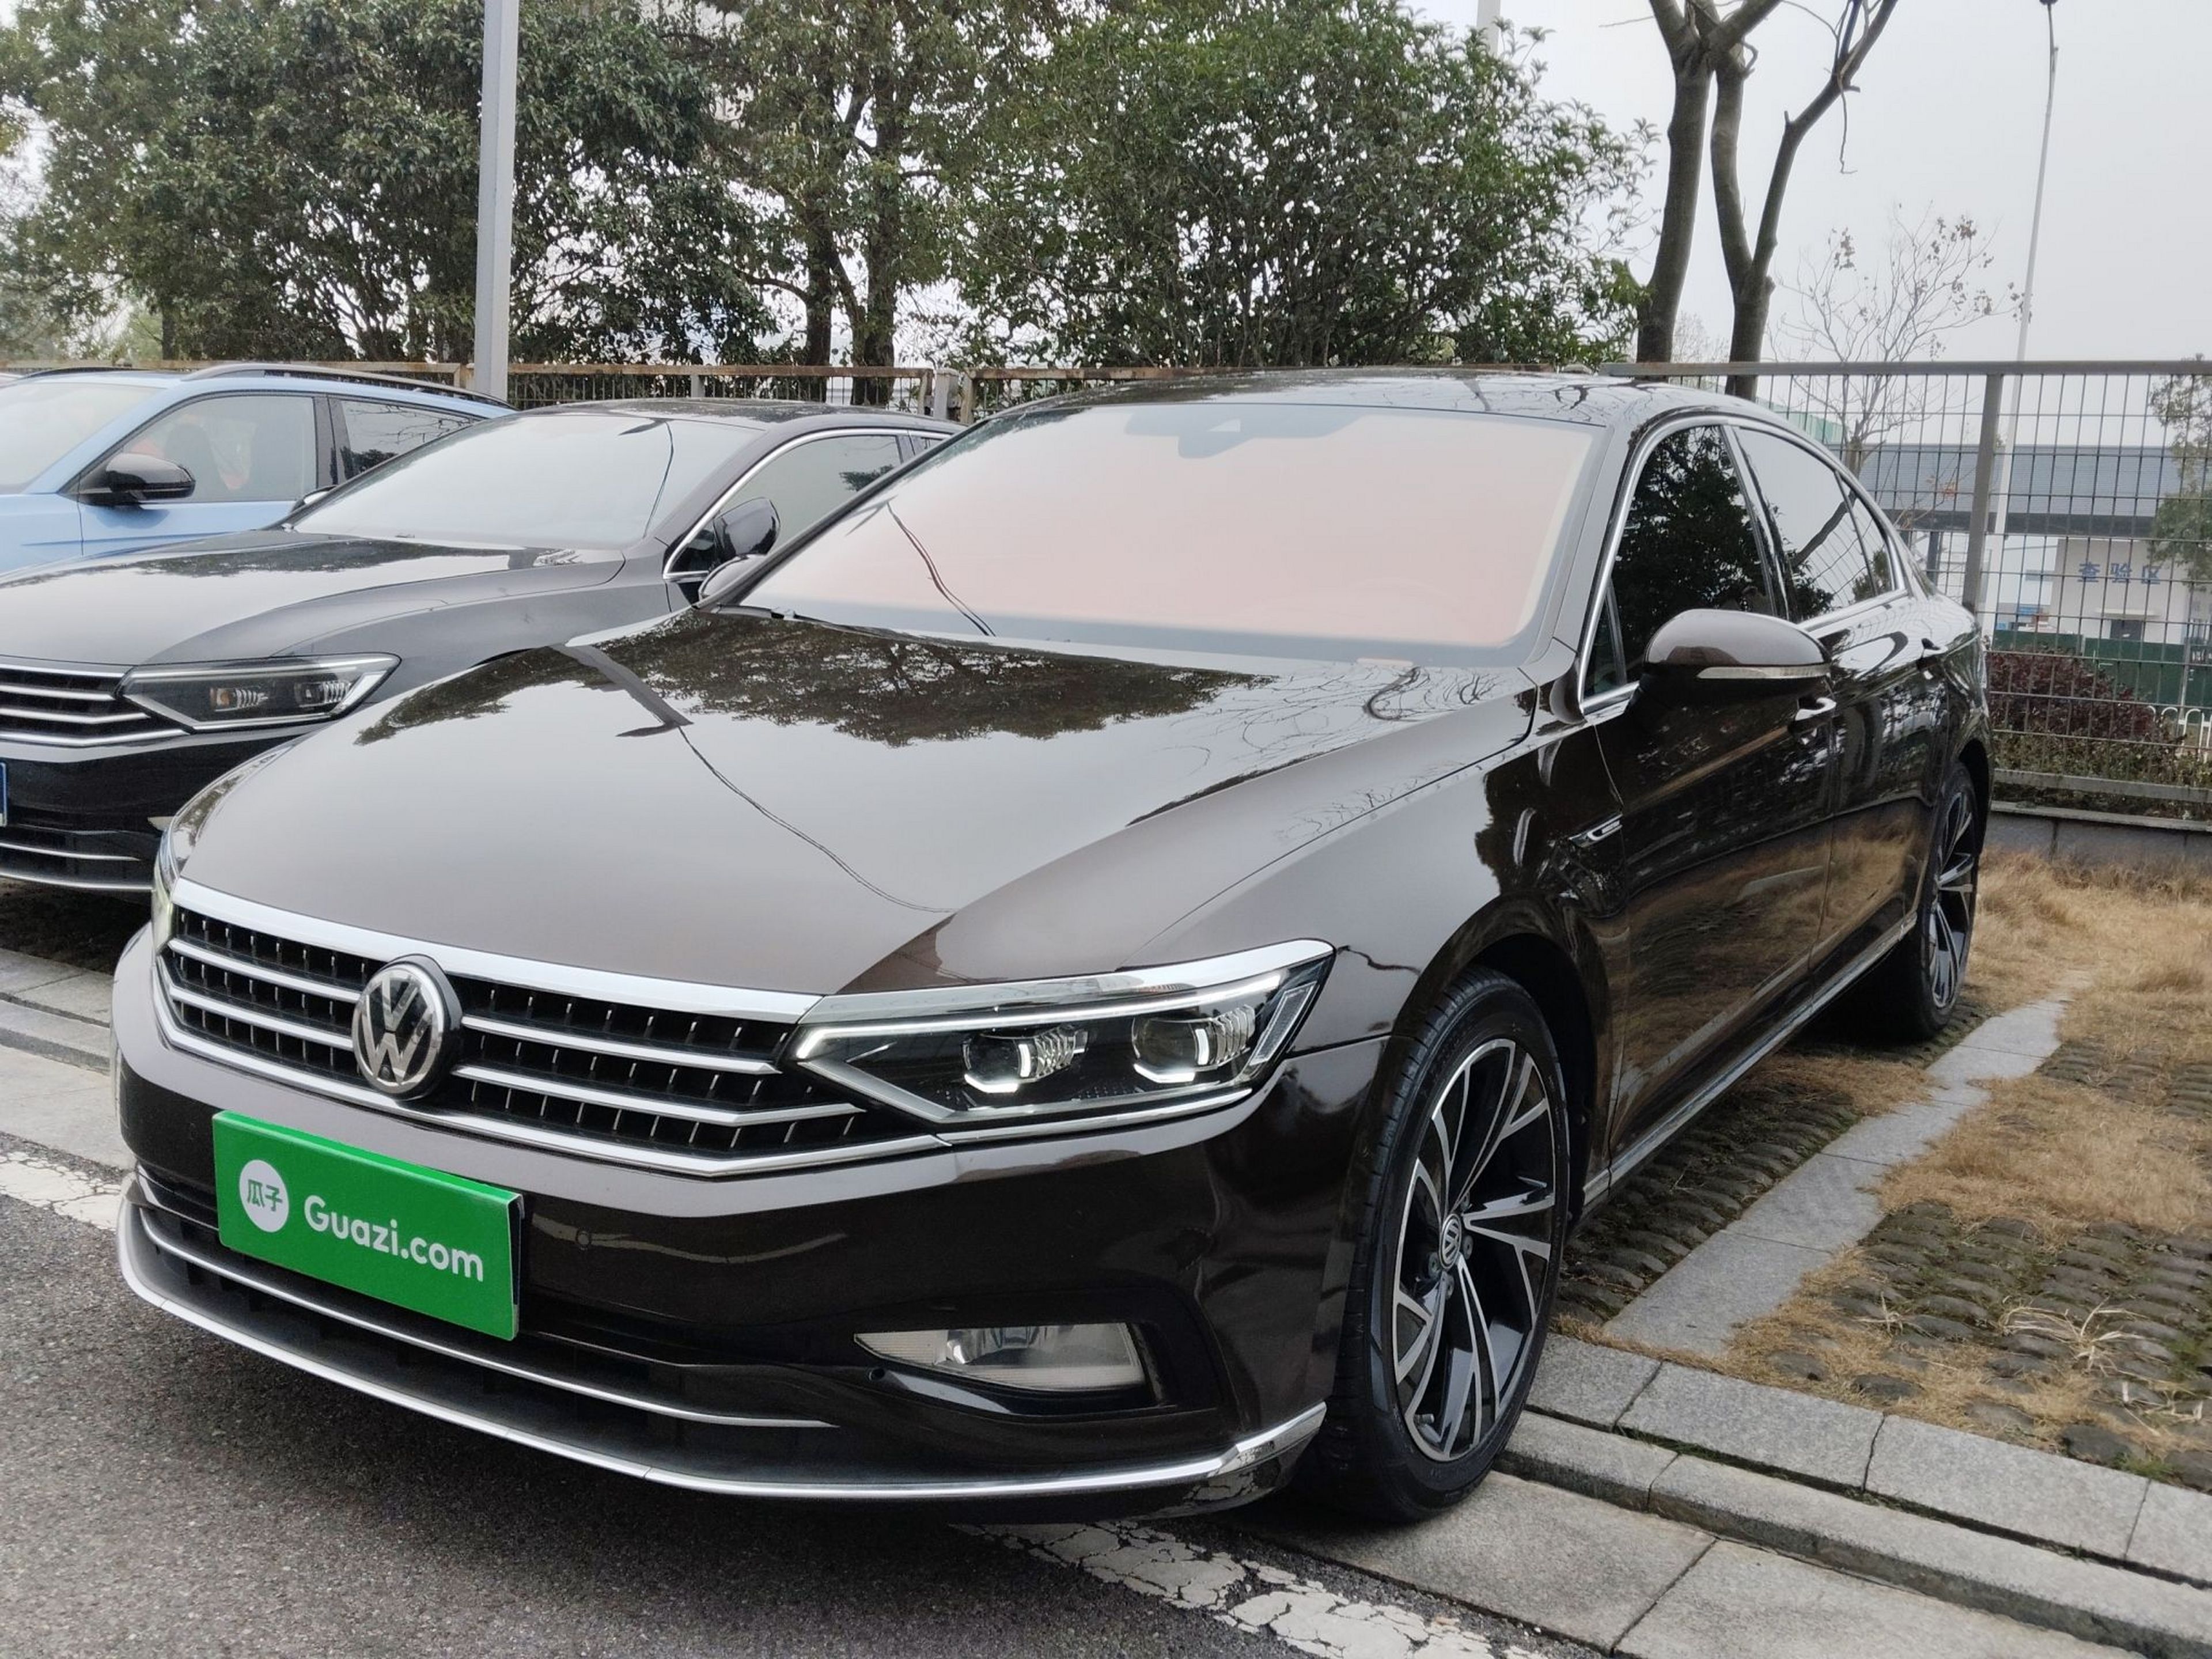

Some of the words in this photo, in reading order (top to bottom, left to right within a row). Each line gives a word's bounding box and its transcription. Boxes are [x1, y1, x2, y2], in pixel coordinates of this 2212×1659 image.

[2077, 562, 2161, 584] 查验区
[247, 1179, 283, 1211] 瓜子
[304, 1195, 483, 1281] Guazi.com
